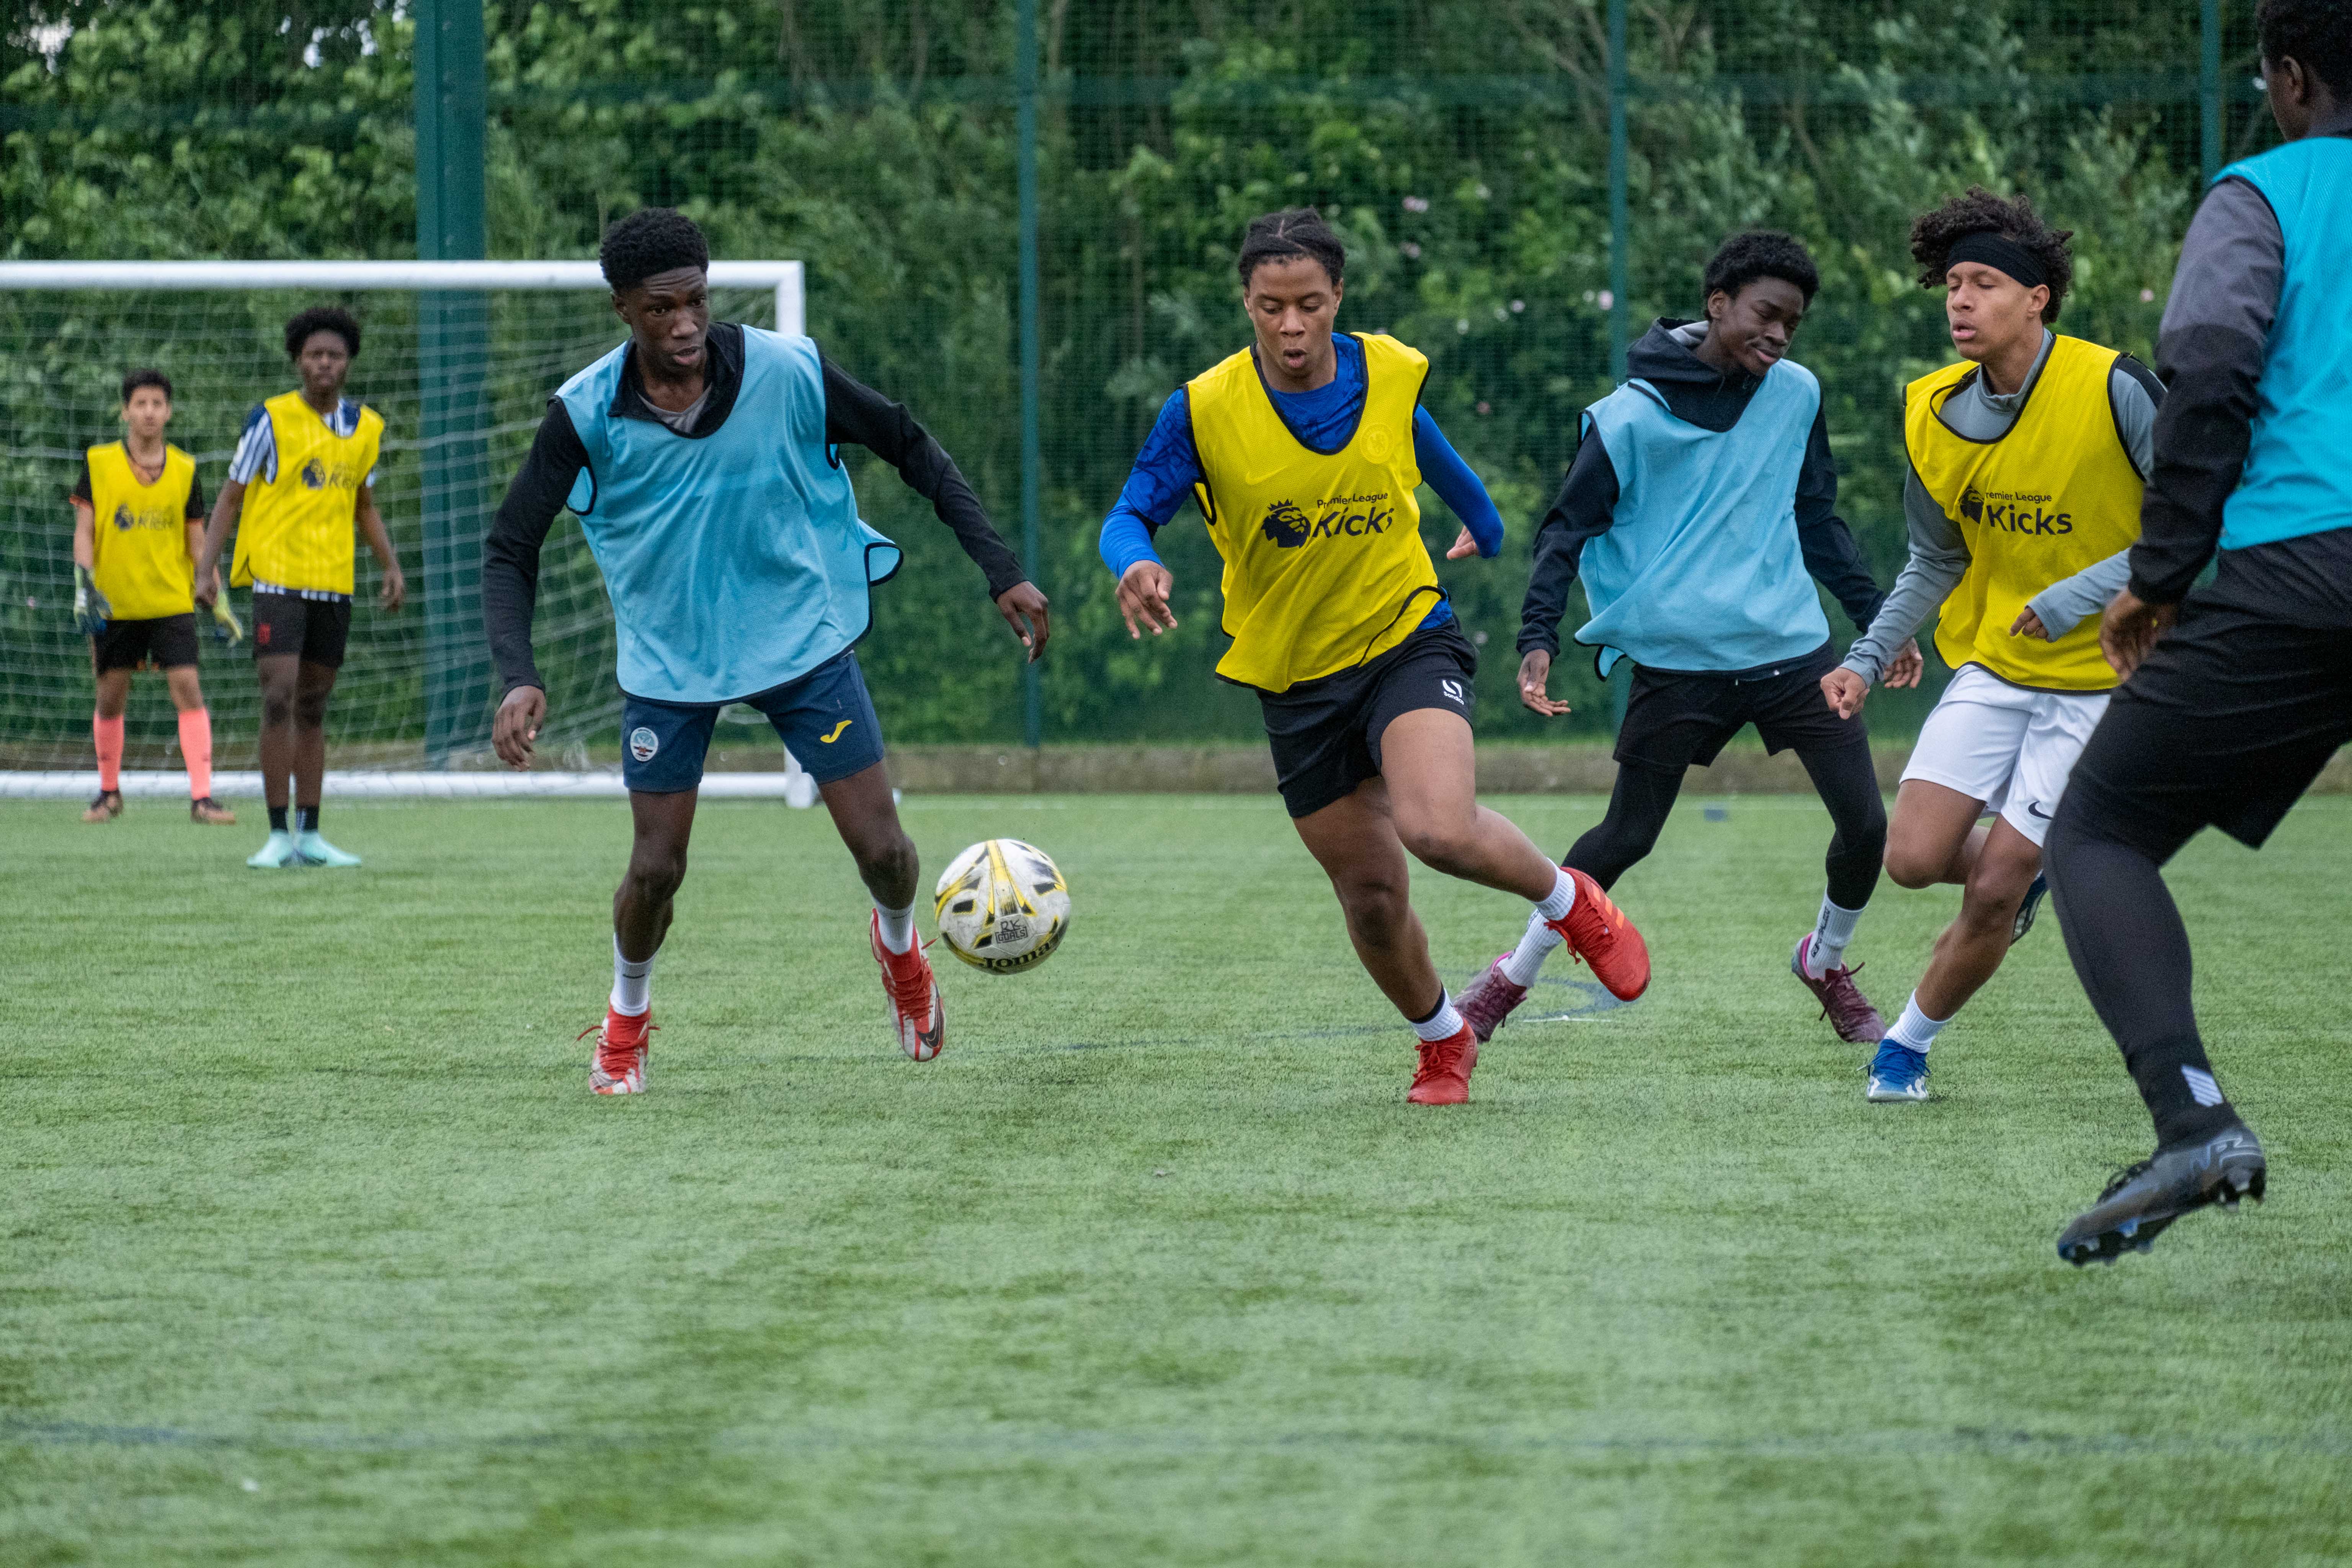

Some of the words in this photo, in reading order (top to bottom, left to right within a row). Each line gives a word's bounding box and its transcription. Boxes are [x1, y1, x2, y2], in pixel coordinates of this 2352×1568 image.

[1352, 493, 1388, 503] League
[1986, 491, 2013, 500] remier
[2015, 492, 2052, 504] League
[1986, 504, 2073, 535] Kicks
[1000, 919, 1021, 933] RK
[998, 929, 1025, 941] GOALS
